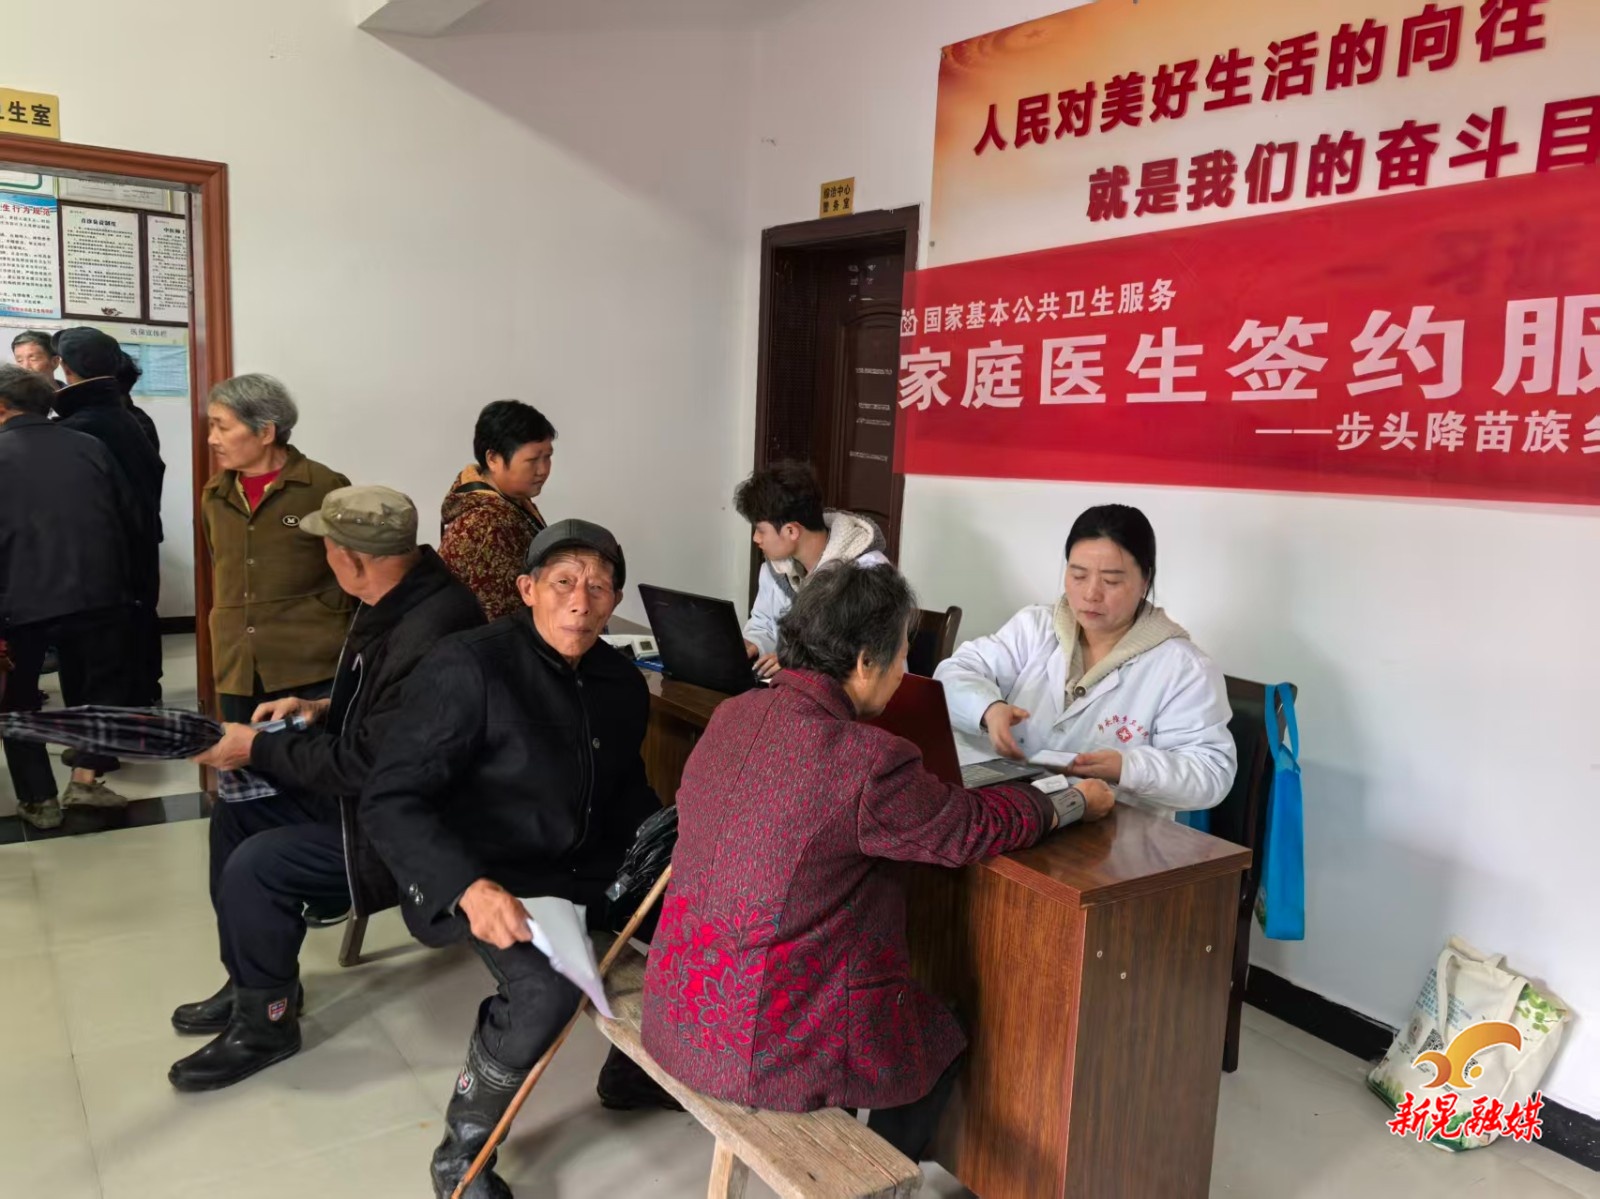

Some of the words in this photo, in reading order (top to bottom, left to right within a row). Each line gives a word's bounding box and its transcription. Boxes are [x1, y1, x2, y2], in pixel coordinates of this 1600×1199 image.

[0, 100, 51, 127] 生室
[973, 0, 1547, 156] 人民对美好生活的向往
[1086, 95, 1600, 222] 就是我们的奋斗目
[0, 203, 50, 216] 生行为规范
[923, 278, 1177, 335] 国家基本公共卫生服务
[898, 293, 1600, 412] 家庭医生签约服
